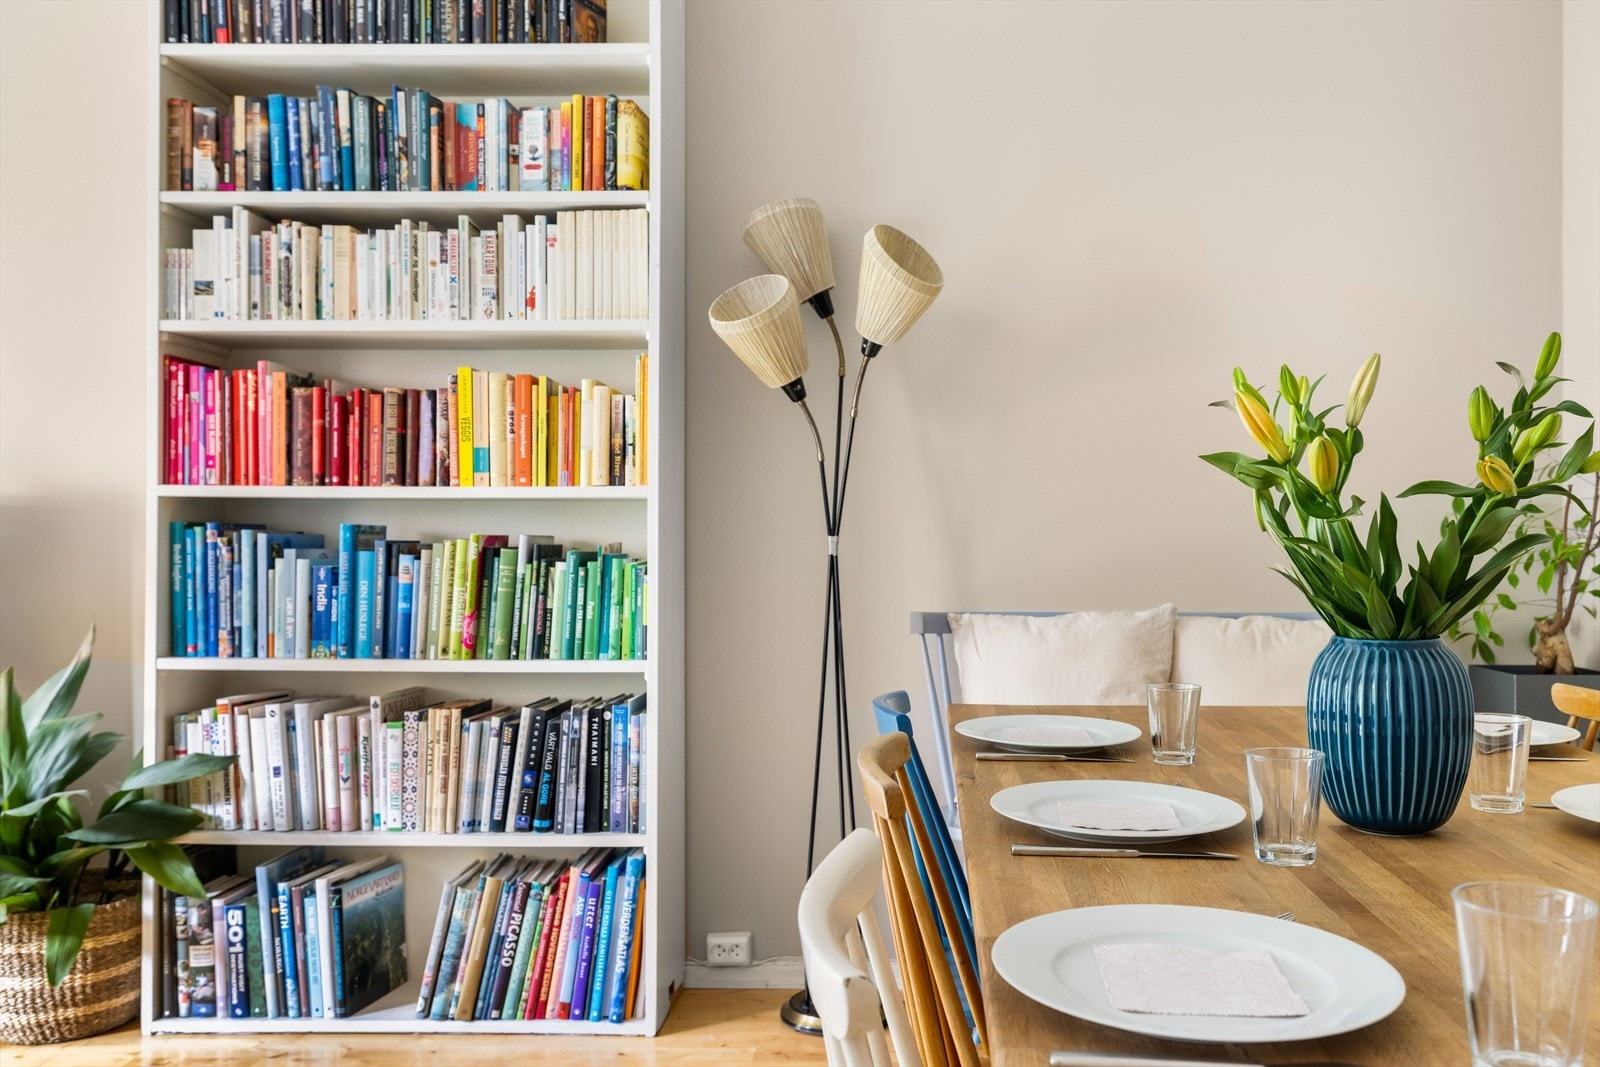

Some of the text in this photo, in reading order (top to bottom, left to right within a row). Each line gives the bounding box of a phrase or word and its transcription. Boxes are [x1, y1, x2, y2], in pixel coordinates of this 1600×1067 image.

[467, 132, 475, 173] SHANTARAM
[484, 235, 495, 275] KHARTOUM
[461, 417, 471, 443] VEGGIS
[470, 542, 478, 560] ASIA
[285, 598, 293, 615] LÆR
[317, 584, 327, 611] India
[431, 586, 439, 631] KLIMADUGNAD
[457, 587, 466, 632] TINGENES
[567, 574, 575, 605] Kristiansen
[587, 601, 595, 619] Pasta
[359, 581, 368, 641] DIN HUSLEGE
[361, 736, 370, 772] Kjøttfrie
[451, 745, 459, 769] MAYA
[529, 716, 541, 766] ECOLOGY
[591, 717, 599, 766] THAIMANI
[539, 732, 558, 806] VÅRT VALG AL GORE
[278, 895, 288, 928] EARTH
[501, 881, 526, 967] Essential PICASSO
[554, 882, 567, 926] Europas
[571, 882, 587, 940] THE ASIA BOOK
[585, 898, 597, 928] urter
[227, 909, 244, 953] 501
[581, 935, 590, 959] Arabella
[595, 890, 613, 991] GYLDENDALS FAMILIEATLAS
[615, 901, 632, 973] VERDENSATLAS
[274, 937, 282, 973] NORUEGA
[540, 927, 560, 1001] HOVEDSTEDER
[230, 954, 238, 1004] DESTINATIONS
